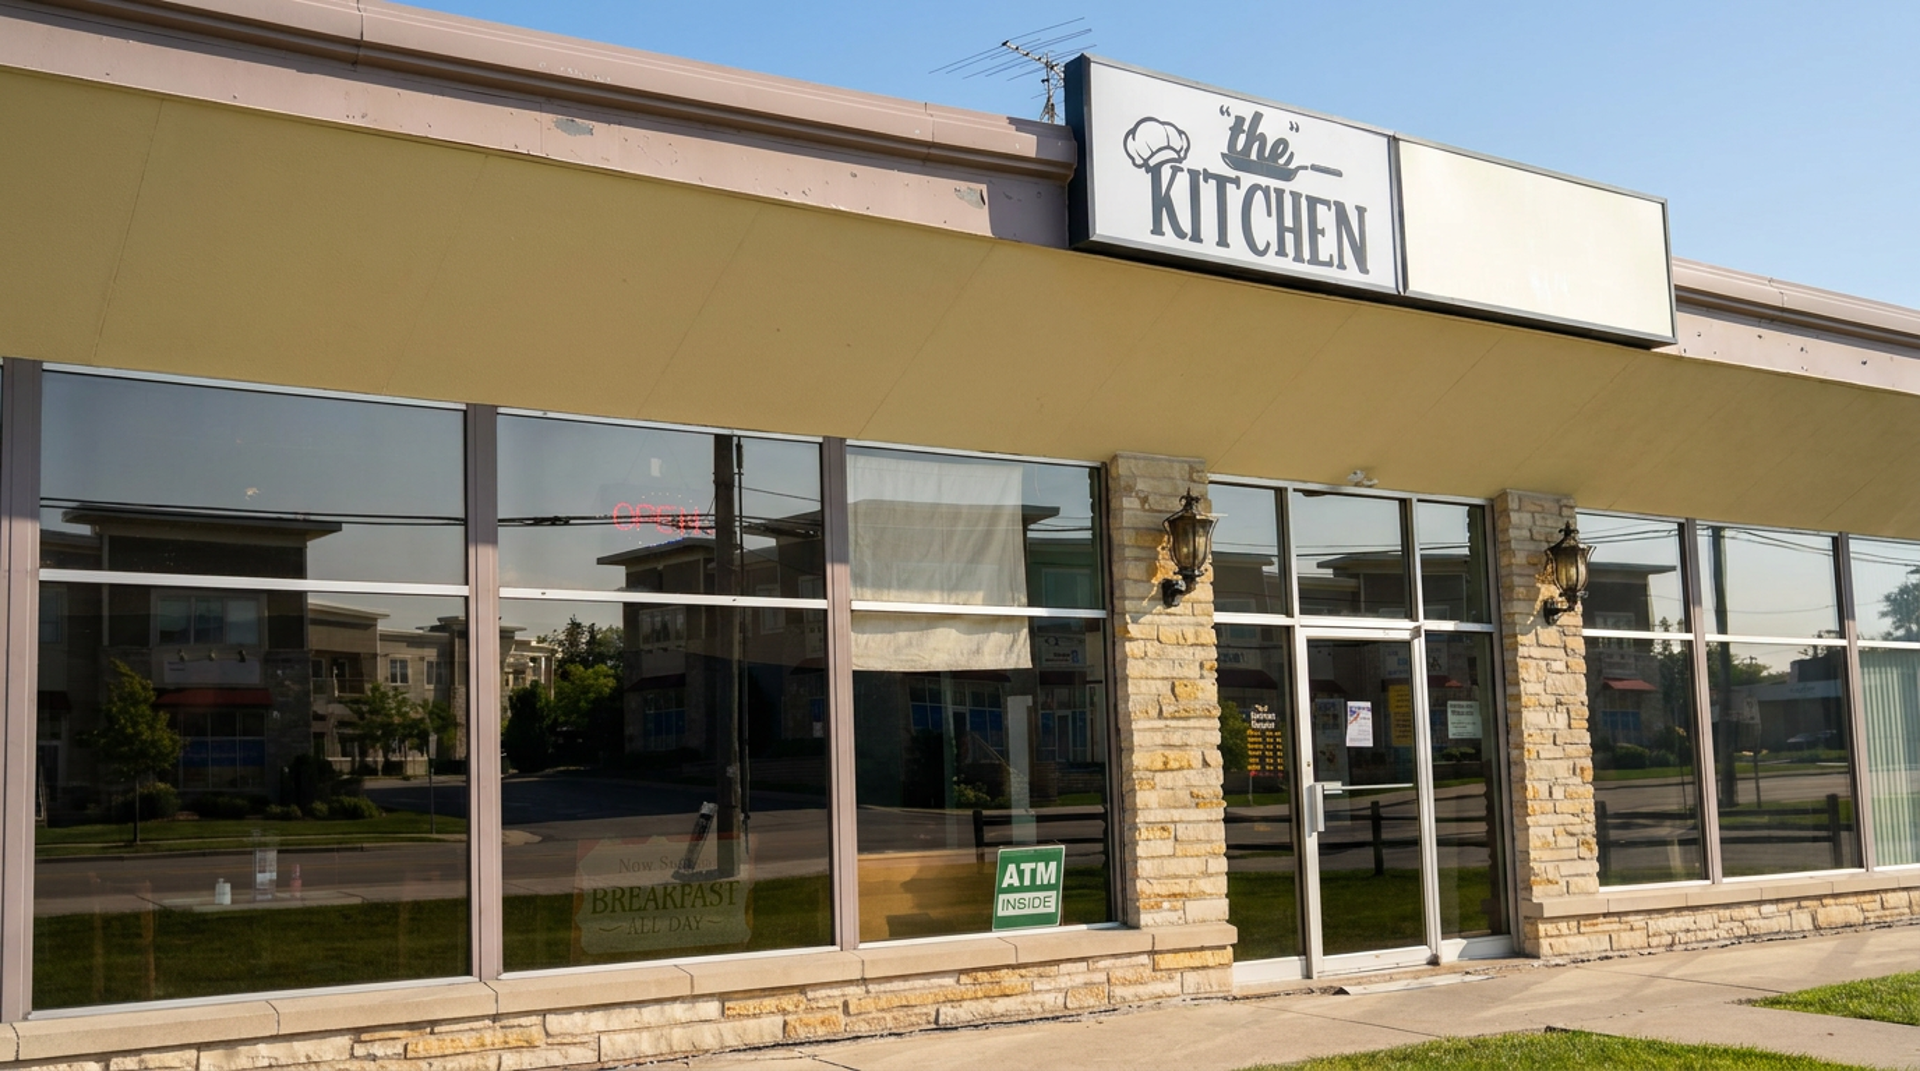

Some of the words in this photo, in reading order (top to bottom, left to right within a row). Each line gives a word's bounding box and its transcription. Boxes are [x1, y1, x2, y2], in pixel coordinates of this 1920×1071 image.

[1149, 164, 1370, 275] KITCHEN
[1001, 861, 1057, 887] ATM
[1001, 895, 1052, 911] INSIDE
[668, 915, 702, 932] DAY
